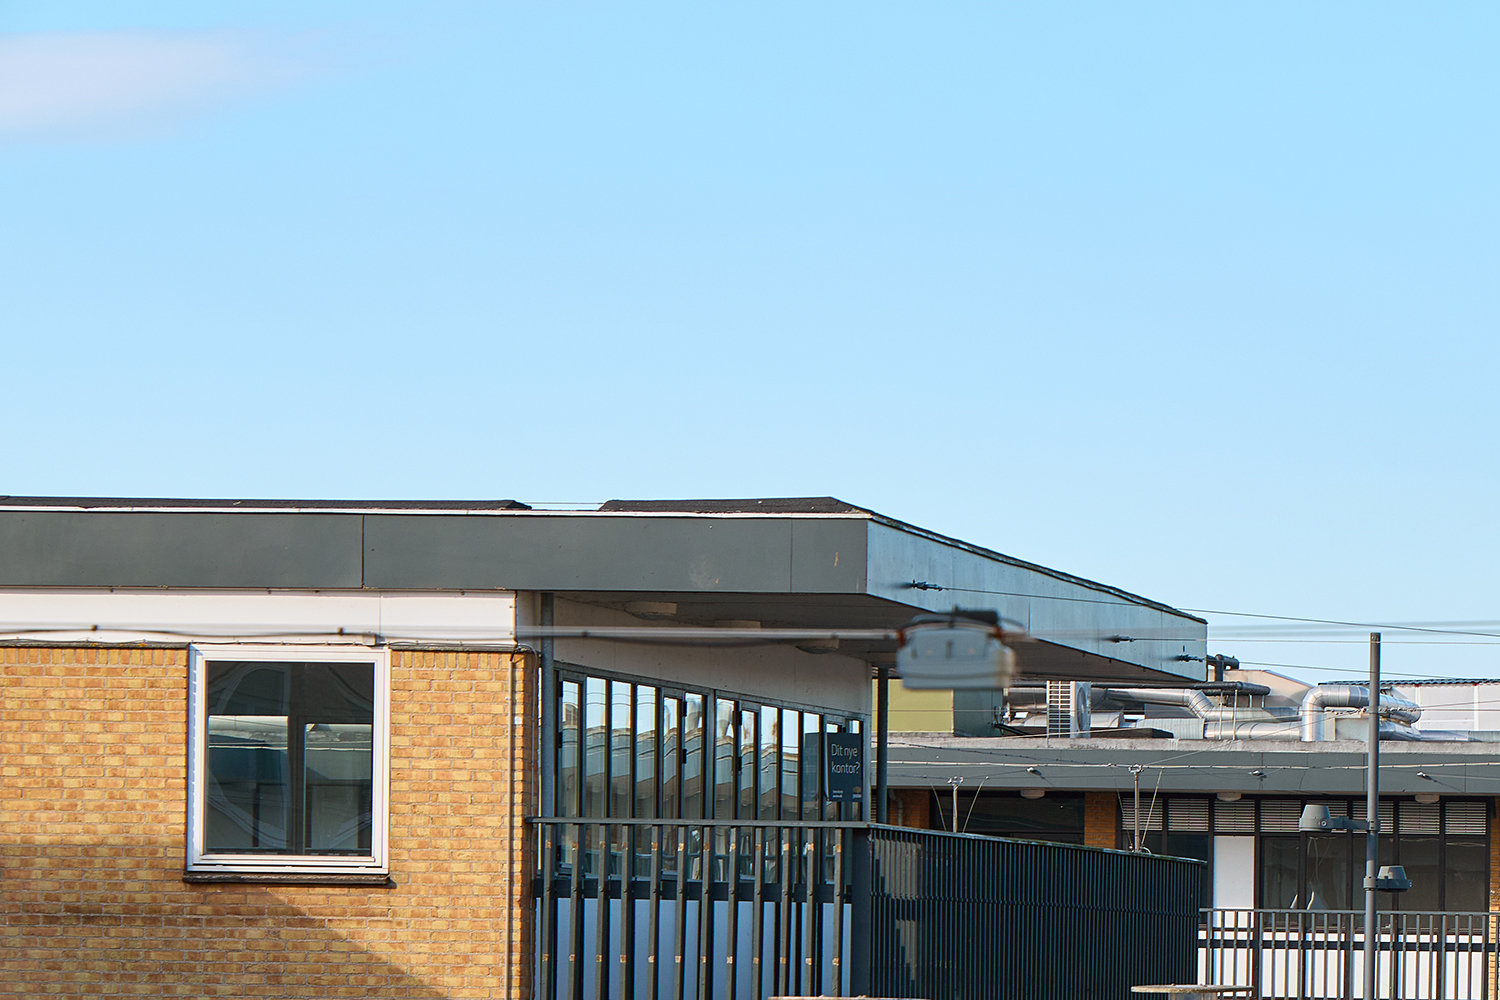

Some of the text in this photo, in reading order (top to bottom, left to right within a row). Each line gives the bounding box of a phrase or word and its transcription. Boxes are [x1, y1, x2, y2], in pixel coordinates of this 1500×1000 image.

[831, 743, 858, 760] Dit nye
[831, 761, 860, 774] kontor?
